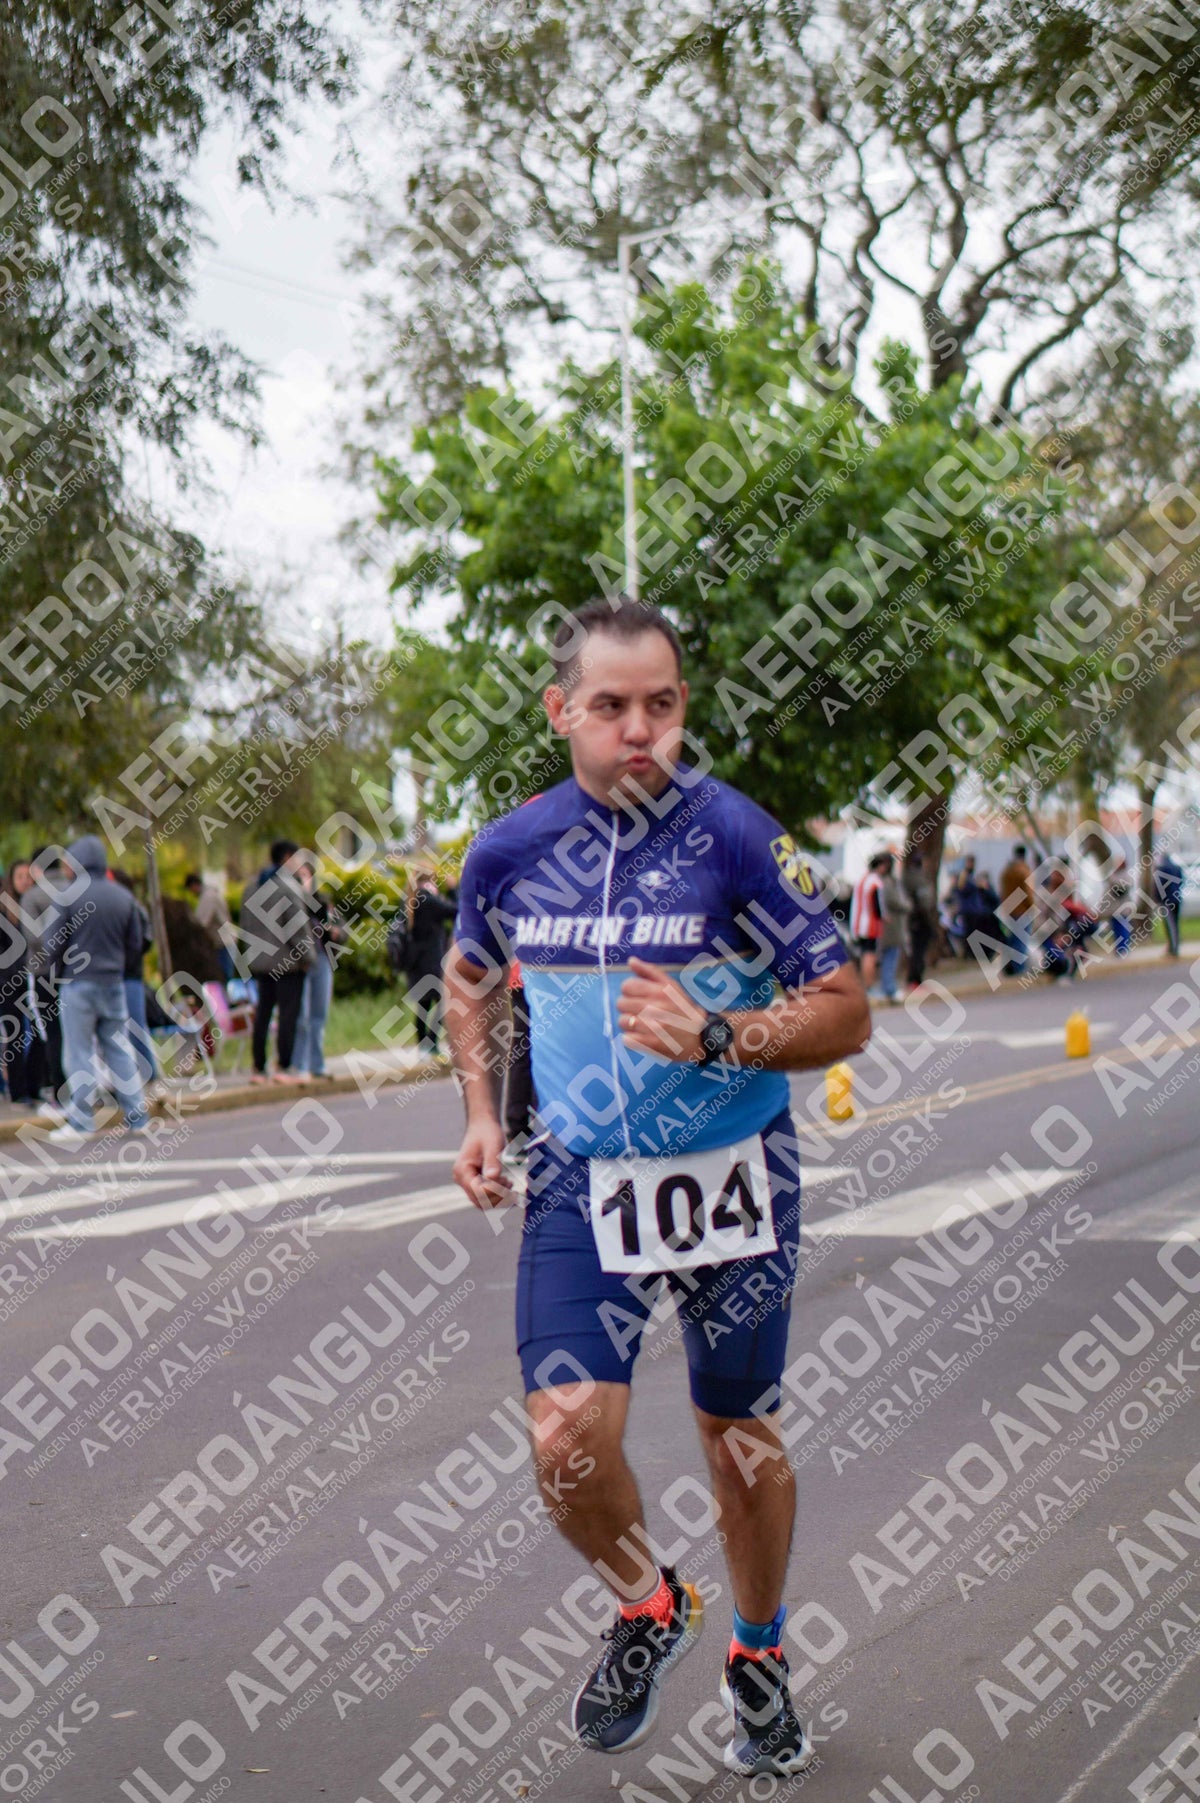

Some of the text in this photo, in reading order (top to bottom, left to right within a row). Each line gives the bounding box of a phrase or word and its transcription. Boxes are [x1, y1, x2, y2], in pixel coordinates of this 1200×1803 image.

[515, 913, 707, 946] MARTIN BIKE
[602, 1160, 764, 1256] 104
